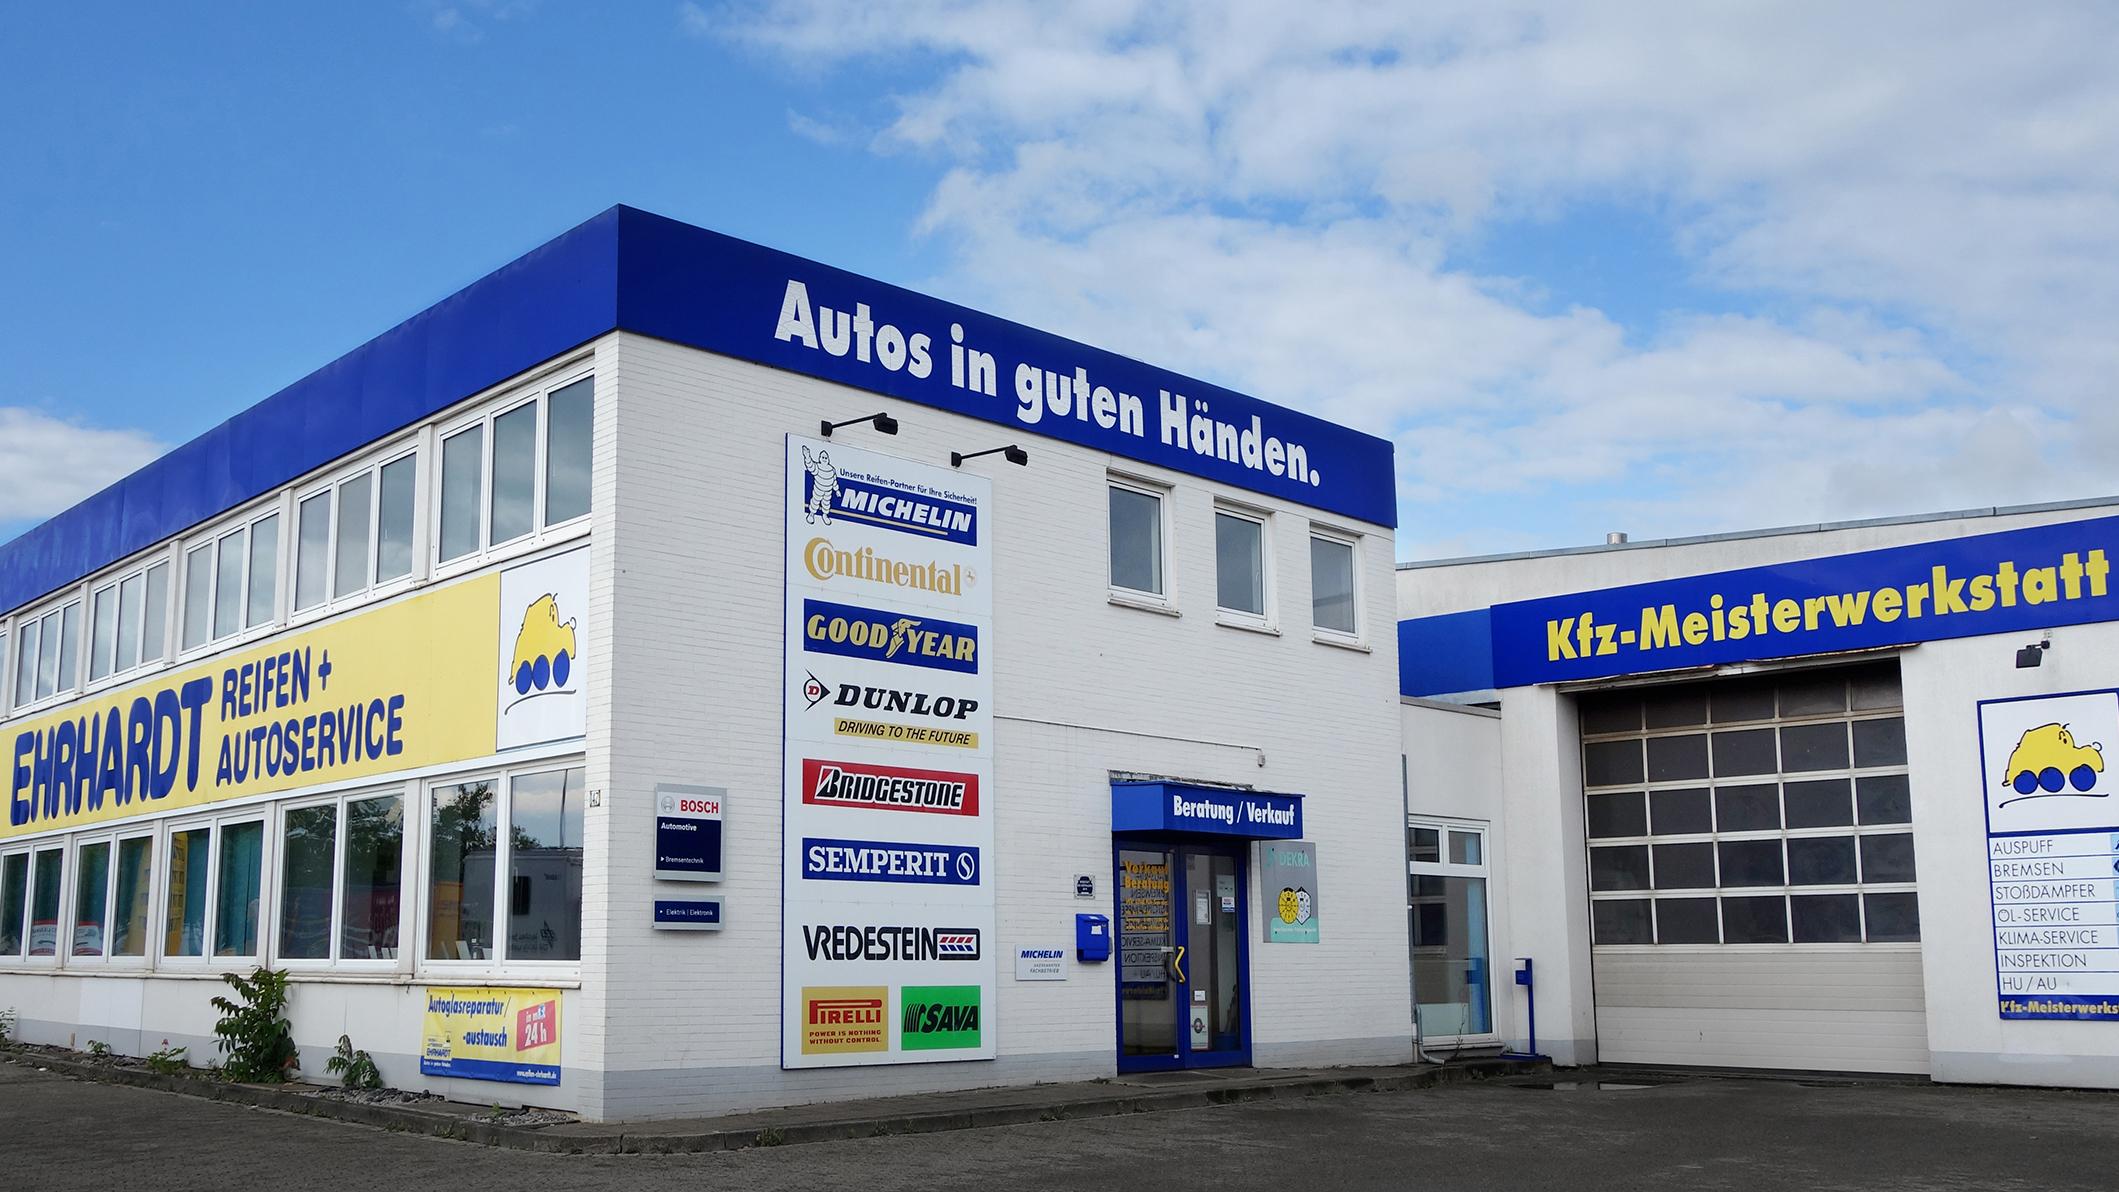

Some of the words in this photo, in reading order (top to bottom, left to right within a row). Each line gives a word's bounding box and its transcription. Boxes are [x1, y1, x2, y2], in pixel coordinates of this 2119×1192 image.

[774, 280, 932, 379] Autos
[950, 324, 997, 397] in
[1015, 363, 1144, 438] guten
[1160, 390, 1321, 487] Händen.
[840, 468, 864, 481] Unsere
[866, 474, 916, 492] Reifen-Partner
[917, 484, 928, 494] für
[929, 487, 942, 498] Ihre
[944, 490, 977, 505] Sicherheit!
[841, 488, 972, 532] MICHELIN
[804, 537, 962, 596] Continental
[1547, 549, 2110, 662] Kfz-Meisterwerkstatt
[221, 646, 311, 722] REIFEN
[318, 650, 332, 690] +
[834, 683, 978, 720] DUNLOP
[216, 695, 405, 788] AUTOSERVICE
[838, 720, 885, 737] DRIVING
[888, 726, 903, 738] TO
[906, 727, 926, 741] THE
[929, 729, 971, 745] FUTURE
[11, 676, 213, 826] EHRHARDT
[816, 767, 964, 808] BRIDGESTONE
[680, 799, 719, 814] BOSCH
[1173, 795, 1233, 825] Beratung
[1247, 802, 1295, 825] Verkauf
[661, 822, 697, 832] Automotive
[665, 856, 704, 864] Bremsentechnik
[1280, 852, 1311, 867] DEKRA
[1993, 840, 2053, 855] AUSPUFF
[808, 846, 949, 877] SEMPERIT
[1994, 862, 2064, 877] BREMSEN
[1996, 884, 2096, 900] STOßDÄMPFER
[803, 925, 937, 961] VREDESTEIN
[1999, 930, 2098, 944] KLIMA-SERVICE
[1021, 950, 1063, 958] MICHELIN
[2001, 954, 2087, 967] INSPEKTION
[2003, 977, 2023, 990] HU
[2037, 977, 2057, 990] AU
[809, 999, 882, 1024] PIRELLI
[921, 1003, 978, 1033] SAVA
[2000, 1000, 2119, 1014] Kfz-Meisterwerks
[463, 1026, 508, 1047] -austausch
[525, 1022, 538, 1047] 24
[540, 1022, 547, 1042] h
